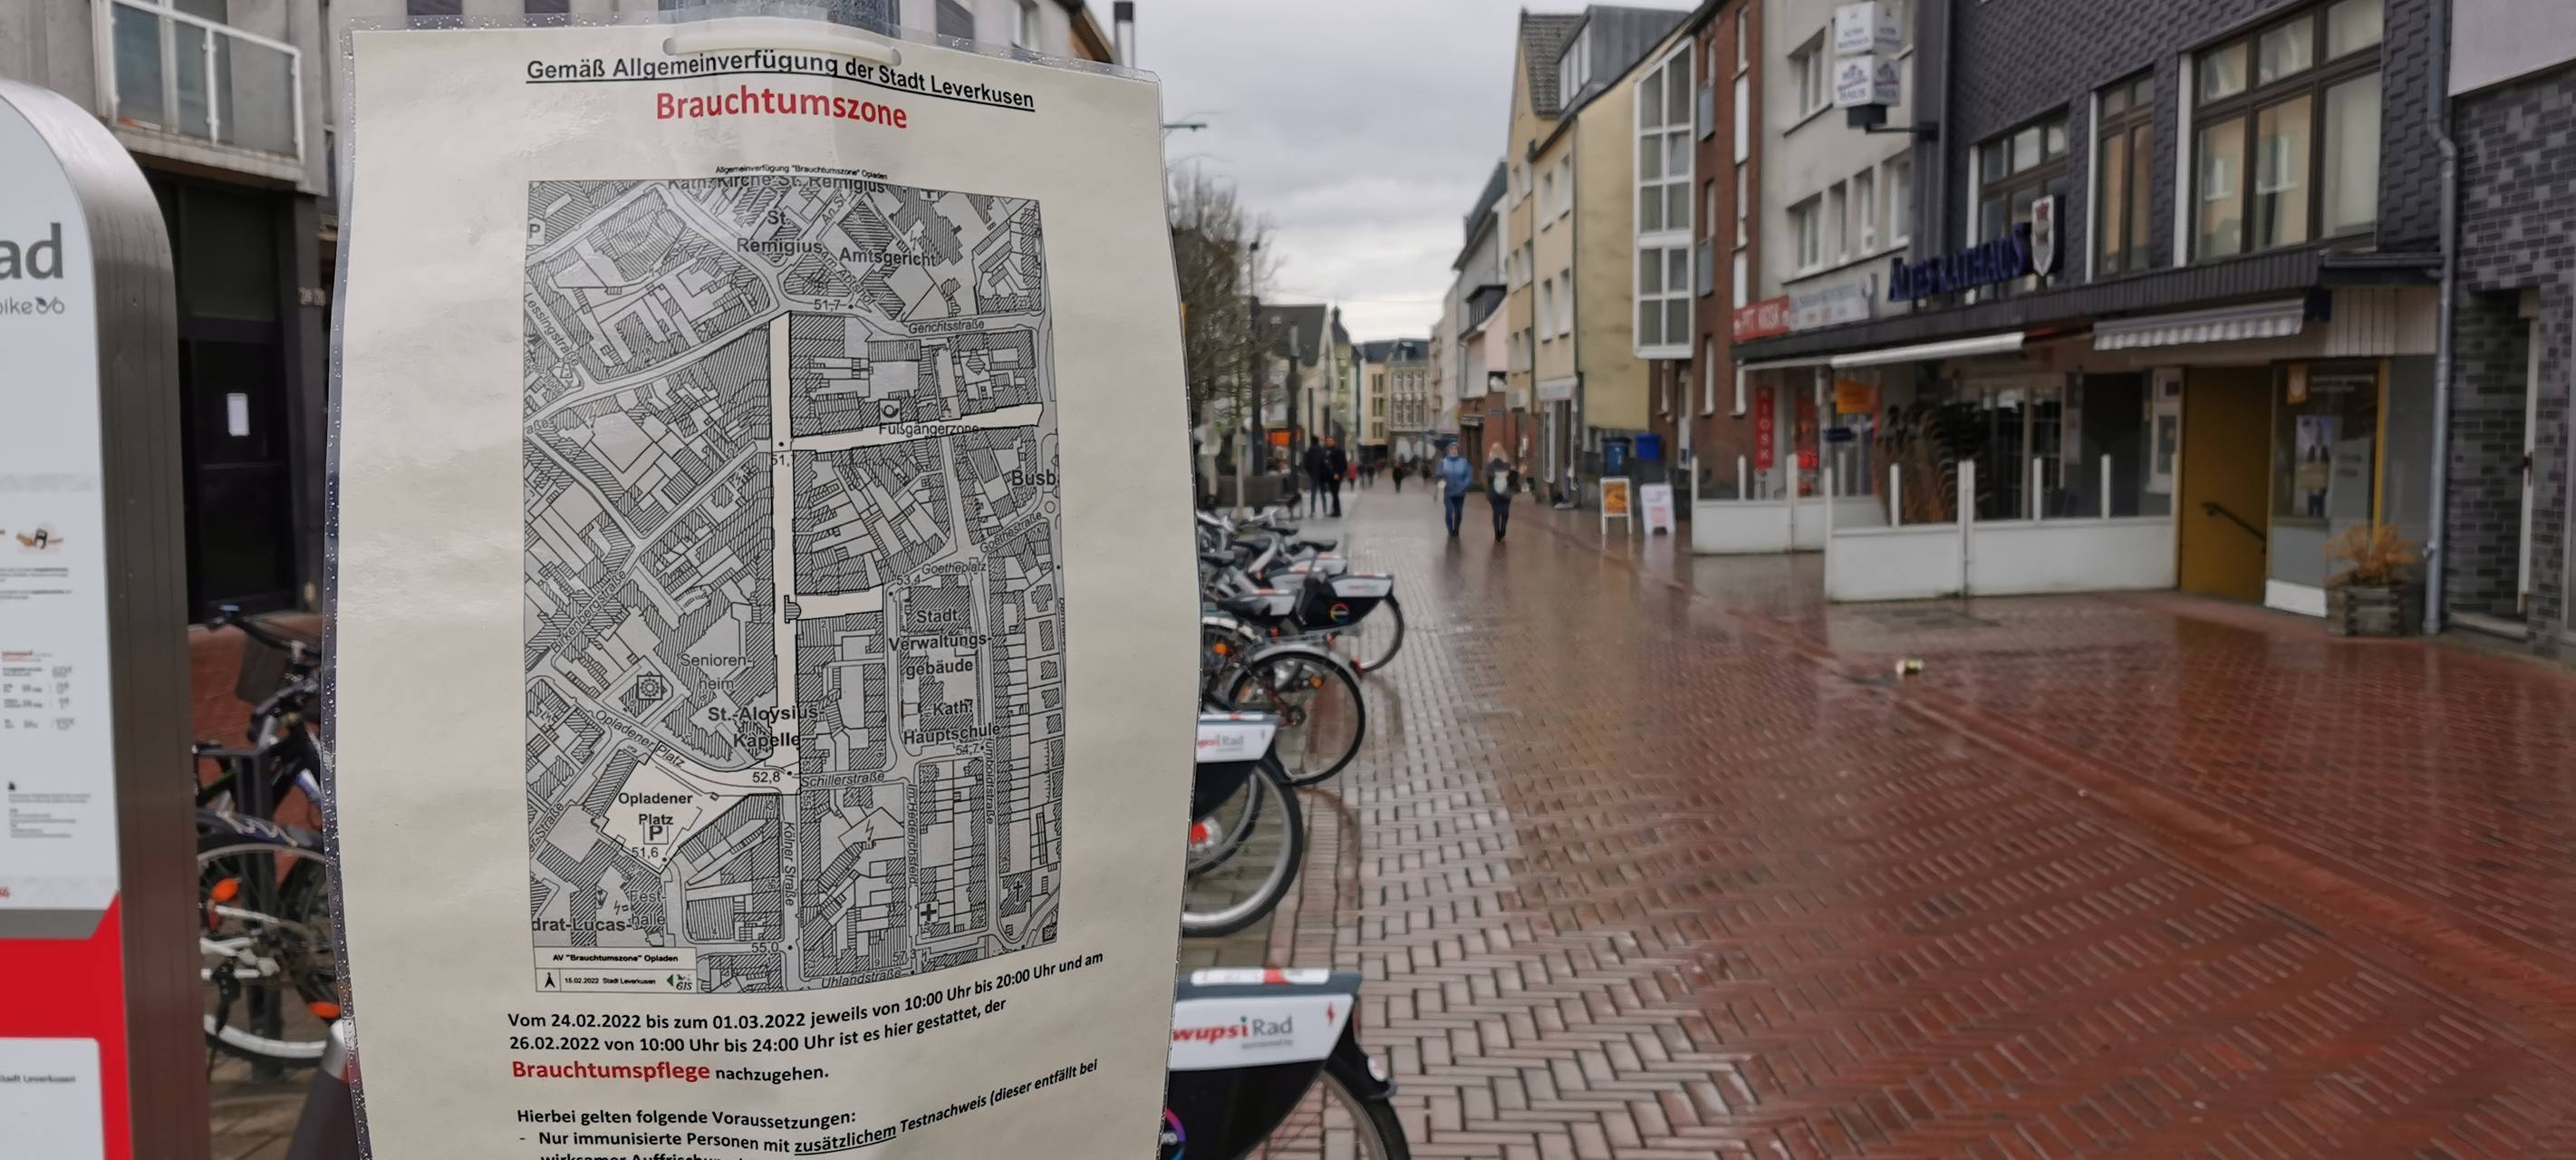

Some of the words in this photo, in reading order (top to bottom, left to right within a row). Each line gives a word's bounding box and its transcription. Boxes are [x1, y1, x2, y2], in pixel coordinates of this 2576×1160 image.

[527, 58, 605, 80] Gemäß
[613, 50, 838, 80] Allgemeinverfügung
[845, 61, 875, 82] der
[879, 63, 926, 92] Stadt
[931, 74, 1035, 109] Leverkusen
[656, 85, 907, 129] Brauchtumszone
[716, 164, 789, 174] Allgemeinverfügung
[792, 165, 860, 176] "Brauchtumszone"
[767, 208, 790, 226] St.
[0, 223, 64, 280] ad
[737, 237, 824, 258] Remigius
[839, 246, 936, 266] Amtsgericht
[908, 319, 985, 334] Gerichtsstraße
[879, 422, 979, 439] Fußgängerzone
[979, 510, 1042, 554] Goethestraße
[921, 559, 987, 575] Goetheplatz
[896, 575, 921, 586] 53,4
[550, 570, 626, 653] Birkenbergstraße
[916, 609, 961, 624] Städt.
[889, 633, 992, 652] Verwaltungs-
[680, 653, 754, 667] Senioren-
[906, 659, 974, 679] gebäude
[699, 676, 736, 690] heim
[708, 704, 825, 723] St.-Aloysius-
[933, 699, 973, 717] Kath.
[595, 710, 655, 750] Opladener
[655, 745, 686, 769] Platz
[733, 731, 800, 753] Kapelle
[904, 722, 1001, 746] Hauptschule
[752, 770, 782, 785] 52,8
[801, 771, 885, 788] Schillerstraße
[618, 792, 693, 807] Opladener
[638, 813, 674, 826] Platz
[648, 826, 664, 841] P
[783, 820, 796, 863] Kölner
[907, 802, 918, 884] Hederichsfeld
[632, 846, 659, 860] 51,6
[785, 864, 796, 907] Straße
[630, 890, 666, 903] Fest-
[632, 913, 667, 926] halle
[751, 941, 779, 954] 55,0
[566, 953, 642, 962] "Brauchtumszone"
[644, 954, 679, 963] Opladen
[564, 977, 599, 985] 15.02.2022
[603, 977, 619, 985] Stadt
[620, 977, 656, 985] Leverkusen
[676, 981, 692, 991] GIS
[821, 967, 902, 989] Uhlandstraße
[507, 1013, 545, 1028] Vom
[551, 1013, 642, 1030] 24.02.2022
[646, 1013, 670, 1030] bis
[673, 1016, 709, 1030] zum
[712, 1012, 806, 1030] 01.03.2022
[809, 1005, 868, 1030] jeweils
[873, 1000, 901, 1017] von
[904, 991, 943, 1012] 10:00
[947, 982, 972, 1001] Uhr
[974, 976, 993, 996] bis
[996, 969, 1031, 991] 20:00
[1033, 963, 1056, 981] Uhr
[1058, 955, 1083, 973] und
[1085, 952, 1104, 968] am
[509, 1036, 601, 1051] 26.02.2022
[604, 1039, 635, 1051] von
[639, 1038, 685, 1052] 10:00
[690, 1038, 720, 1052] Uhr
[724, 1037, 748, 1053] bis
[752, 1037, 799, 1052] 24:00
[804, 1034, 835, 1050] Uhr
[839, 1030, 859, 1047] ist
[863, 1029, 881, 1042] es
[883, 1021, 914, 1039] hier
[915, 1007, 982, 1035] gestattet,
[984, 998, 1007, 1015] der
[1252, 1015, 1294, 1037] Rad
[512, 1060, 710, 1082] Brauchtumspflege
[715, 1066, 830, 1084] nachzugehen.
[539, 1132, 569, 1145] Nur
[574, 1132, 681, 1146] immunisierte
[687, 1133, 758, 1150] Personen
[764, 1138, 790, 1152] mit
[795, 1126, 897, 1155] zusätzlichem
[900, 1096, 987, 1133] Testnachweis
[989, 1080, 1032, 1107] (dieser
[1034, 1065, 1077, 1089] entfällt
[1079, 1058, 1098, 1076] bei
[517, 1109, 575, 1124] Hierbei
[581, 1110, 632, 1126] gelten
[636, 1110, 708, 1126] folgende
[712, 1111, 856, 1131] Voraussetzungen:
